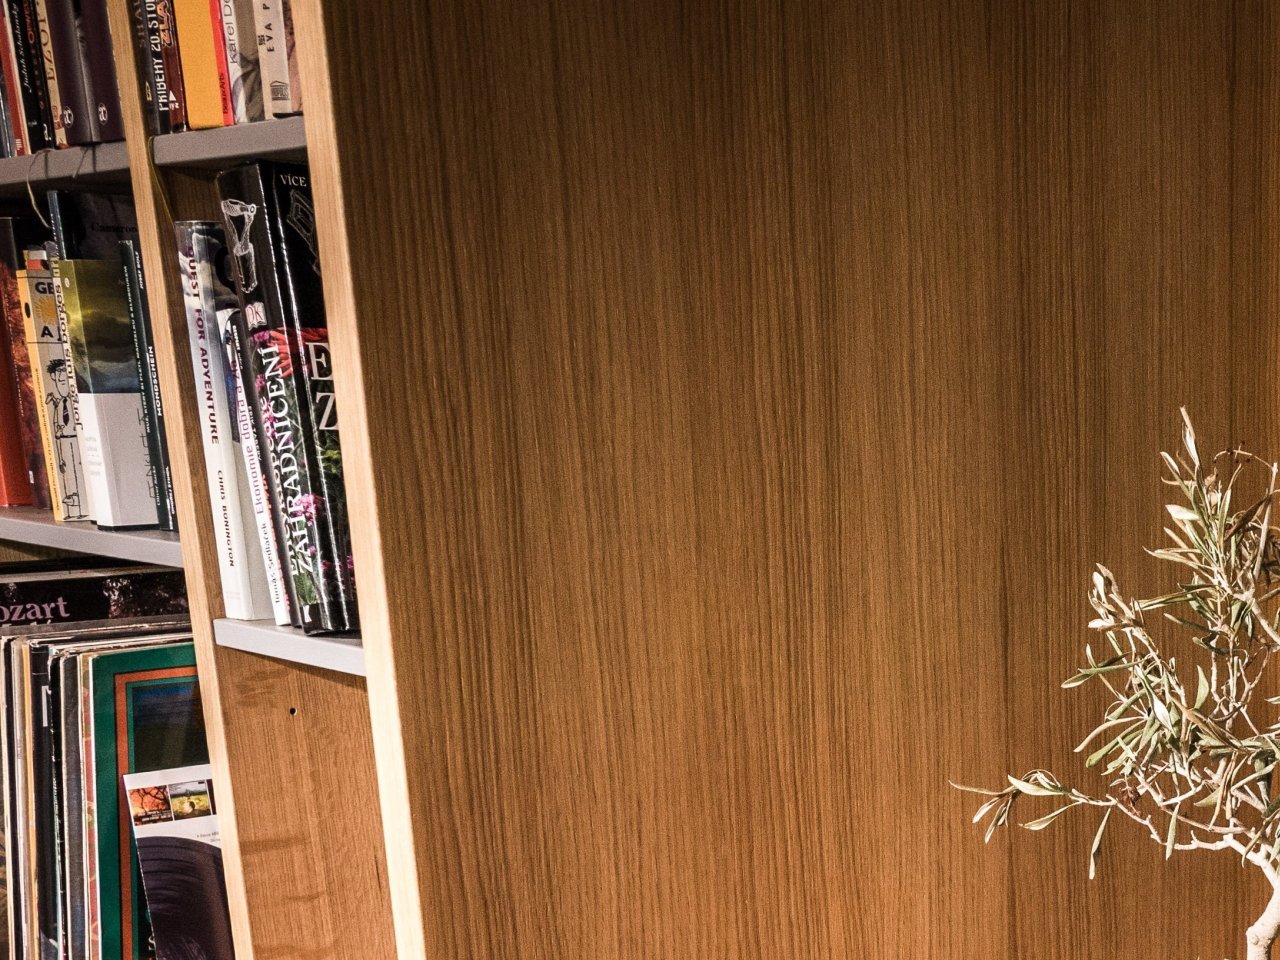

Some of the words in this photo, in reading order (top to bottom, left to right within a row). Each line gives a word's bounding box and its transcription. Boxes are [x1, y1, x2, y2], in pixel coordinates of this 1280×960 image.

[145, 0, 159, 28] STO
[225, 22, 237, 64] Karel
[280, 173, 307, 187] VÍCE
[187, 246, 200, 299] QUEST
[55, 284, 69, 344] borges
[194, 308, 206, 340] FOR
[245, 303, 264, 326] DK
[63, 345, 76, 379] luis
[148, 346, 162, 417] MONDSCHEIN
[70, 384, 83, 431] jorge
[199, 347, 219, 444] ADVENTURE
[236, 400, 252, 440] dobra
[245, 445, 265, 515] Ekonomie
[217, 469, 226, 501] CHRIS
[222, 505, 234, 567] BONINGTON
